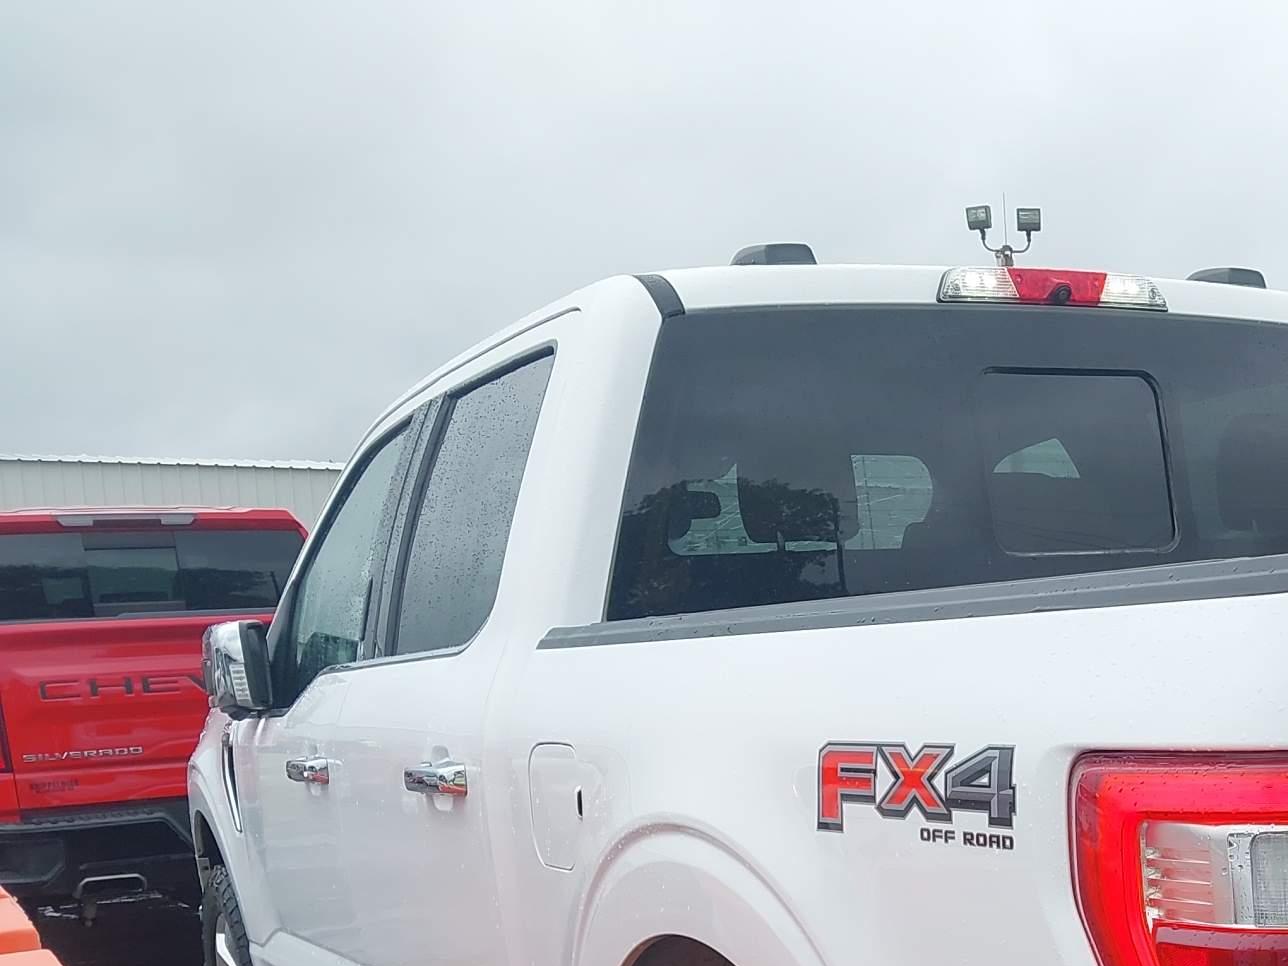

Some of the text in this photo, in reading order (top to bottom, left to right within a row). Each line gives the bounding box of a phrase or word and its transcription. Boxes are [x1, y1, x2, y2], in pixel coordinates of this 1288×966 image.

[22, 746, 144, 763] SILVERADO
[817, 741, 1016, 833] FX4
[920, 827, 1014, 850] OFF ROAD
